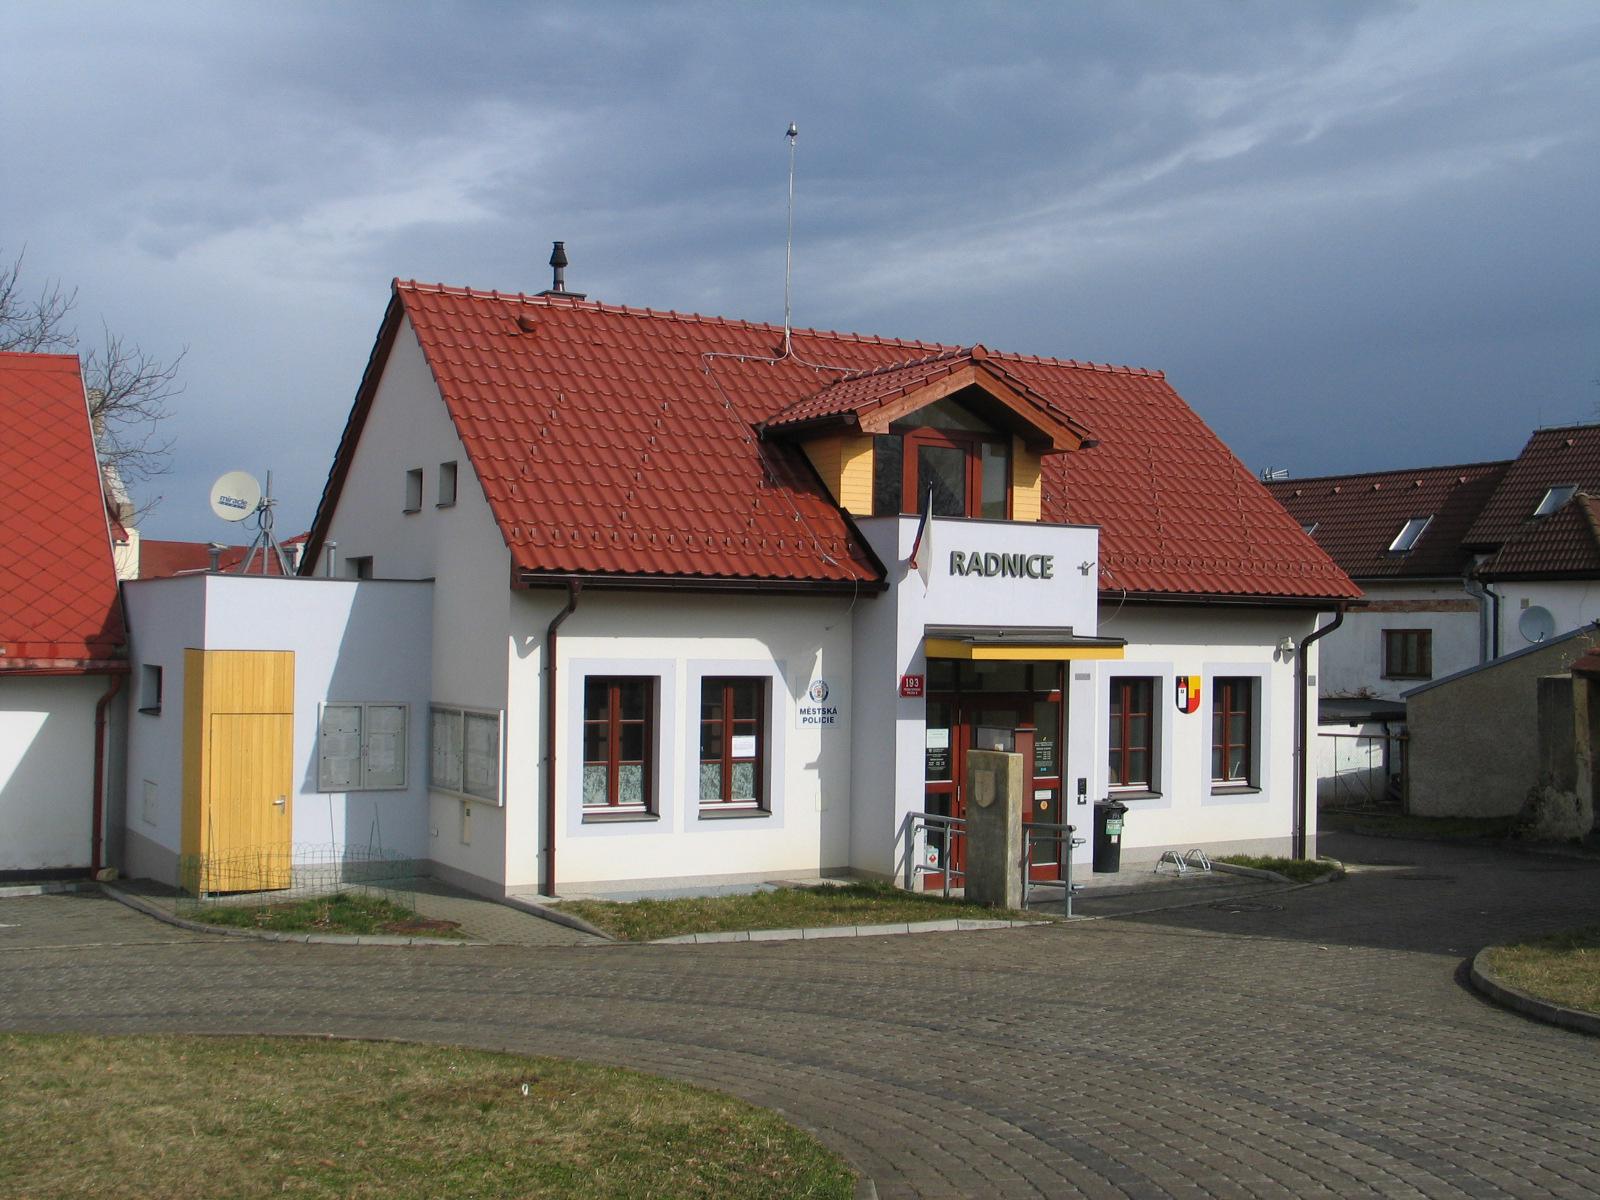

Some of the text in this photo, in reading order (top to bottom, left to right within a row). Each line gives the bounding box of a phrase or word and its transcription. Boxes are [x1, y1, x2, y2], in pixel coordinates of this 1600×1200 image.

[949, 550, 1054, 580] RADNICE
[905, 678, 920, 687] 193
[802, 716, 835, 724] POLICIE
